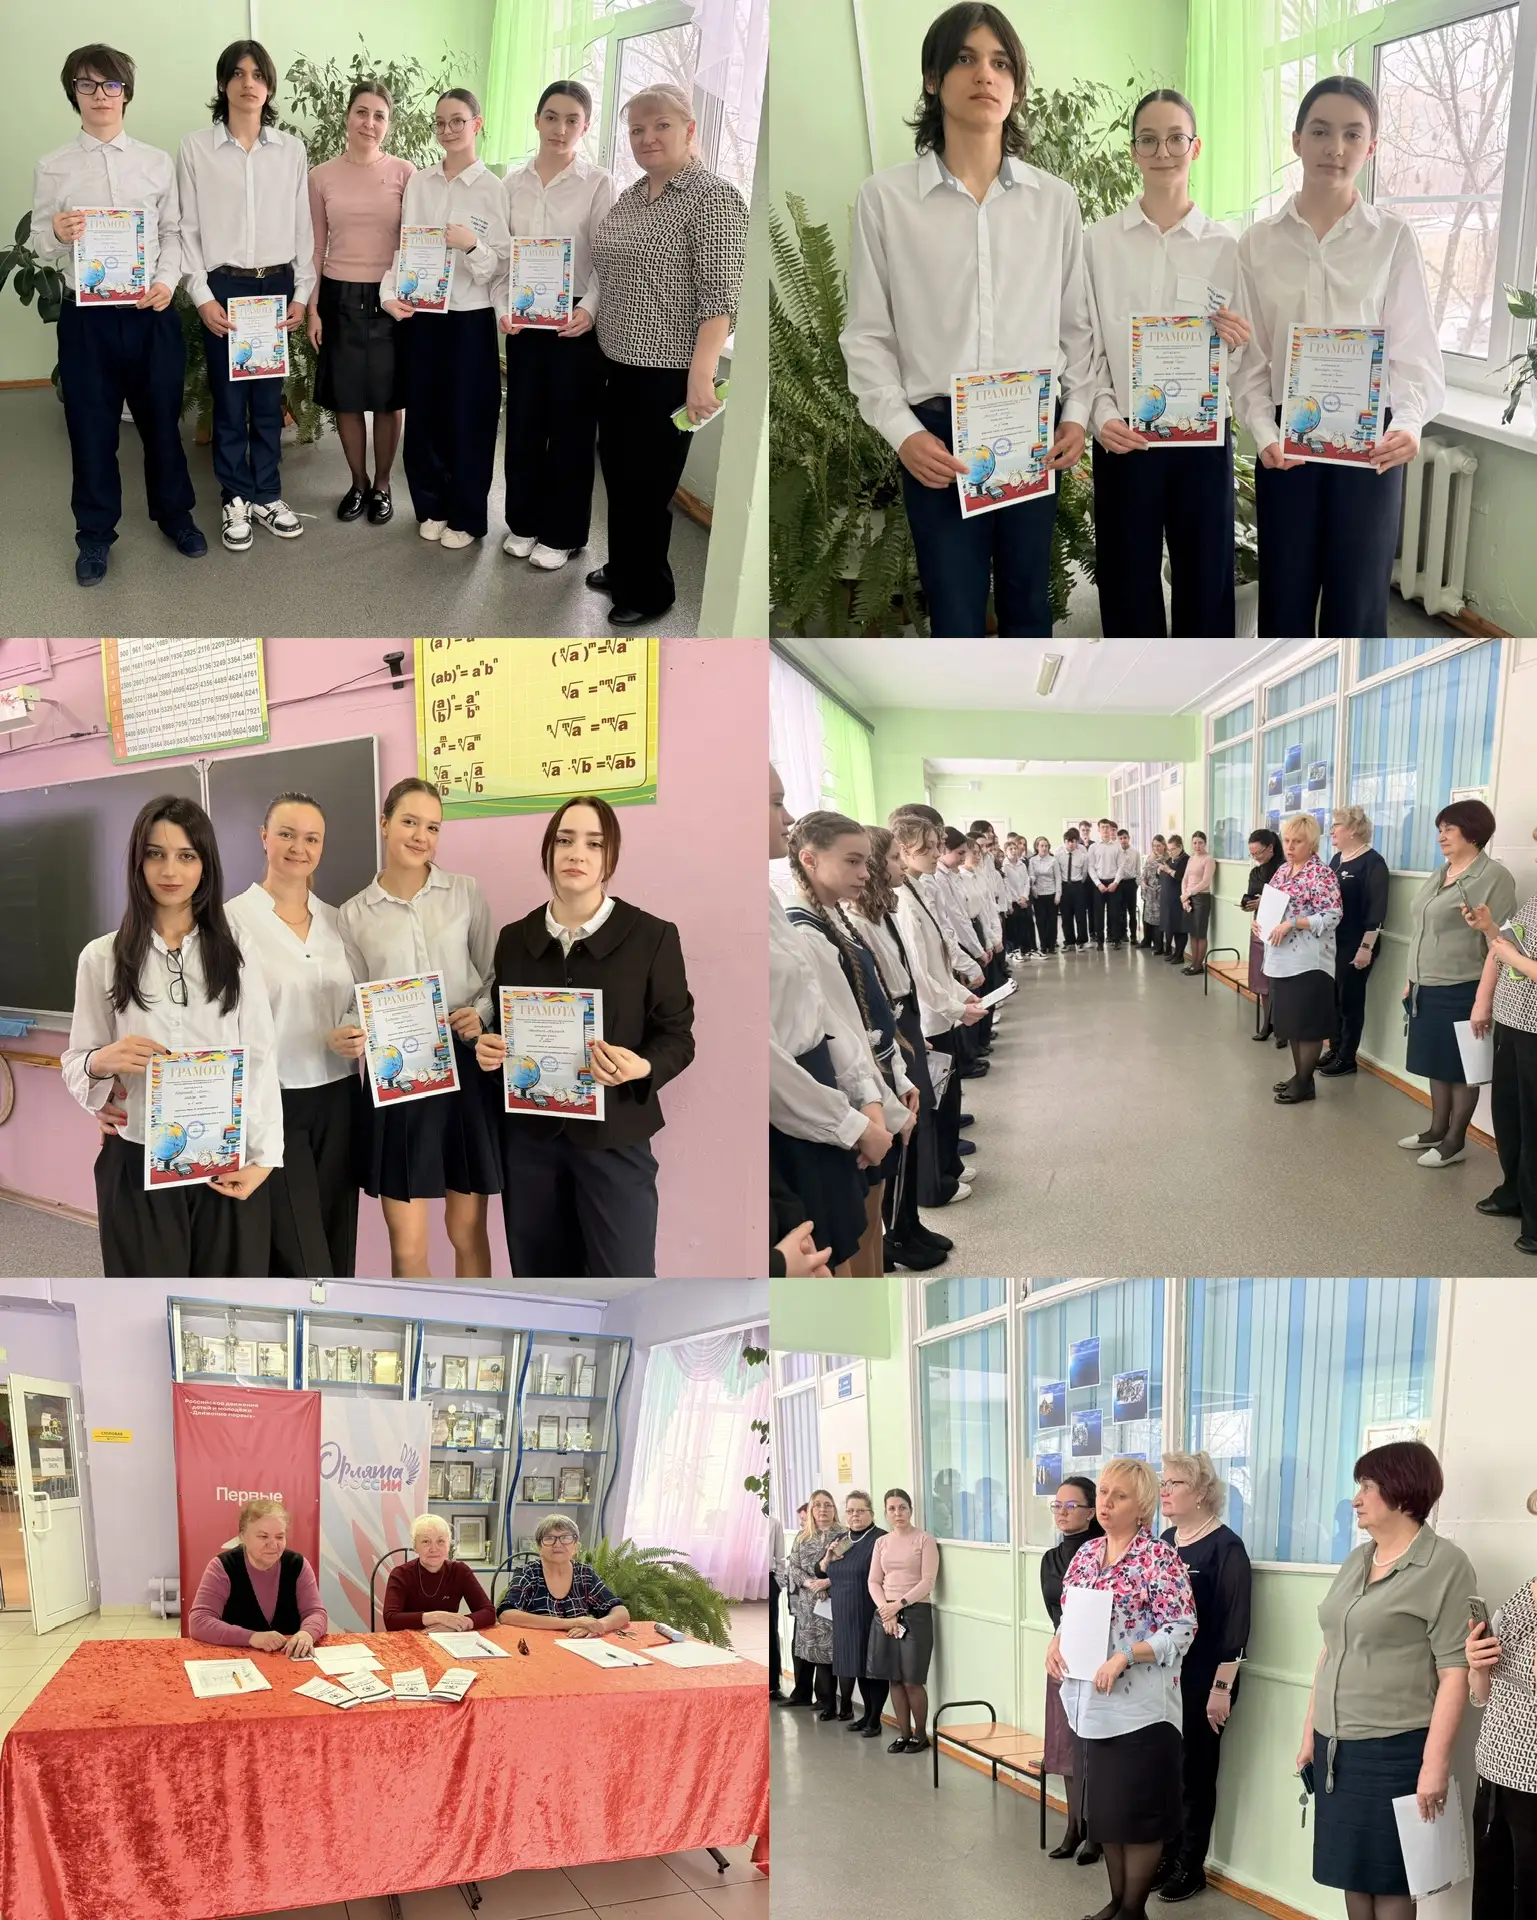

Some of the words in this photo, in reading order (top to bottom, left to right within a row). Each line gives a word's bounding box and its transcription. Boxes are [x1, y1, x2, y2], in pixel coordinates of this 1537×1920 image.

[90, 220, 131, 229] ГРАМОТА
[411, 235, 443, 245] ГРАМОТА
[523, 248, 560, 257] ГРАМОТА
[240, 306, 273, 315] ГРАМОТА
[1149, 331, 1203, 342] ГРАМОТА
[1309, 343, 1364, 355] ГРАМОТА
[976, 385, 1032, 400] ГРАМОТА
[377, 990, 426, 1006] ГРАМОТА
[520, 1004, 576, 1017] ГРАМОТА
[171, 1064, 226, 1078] ГРАМОТА
[184, 1398, 225, 1406] Российское
[320, 1441, 404, 1484] Орлята
[216, 1486, 283, 1507] Первые
